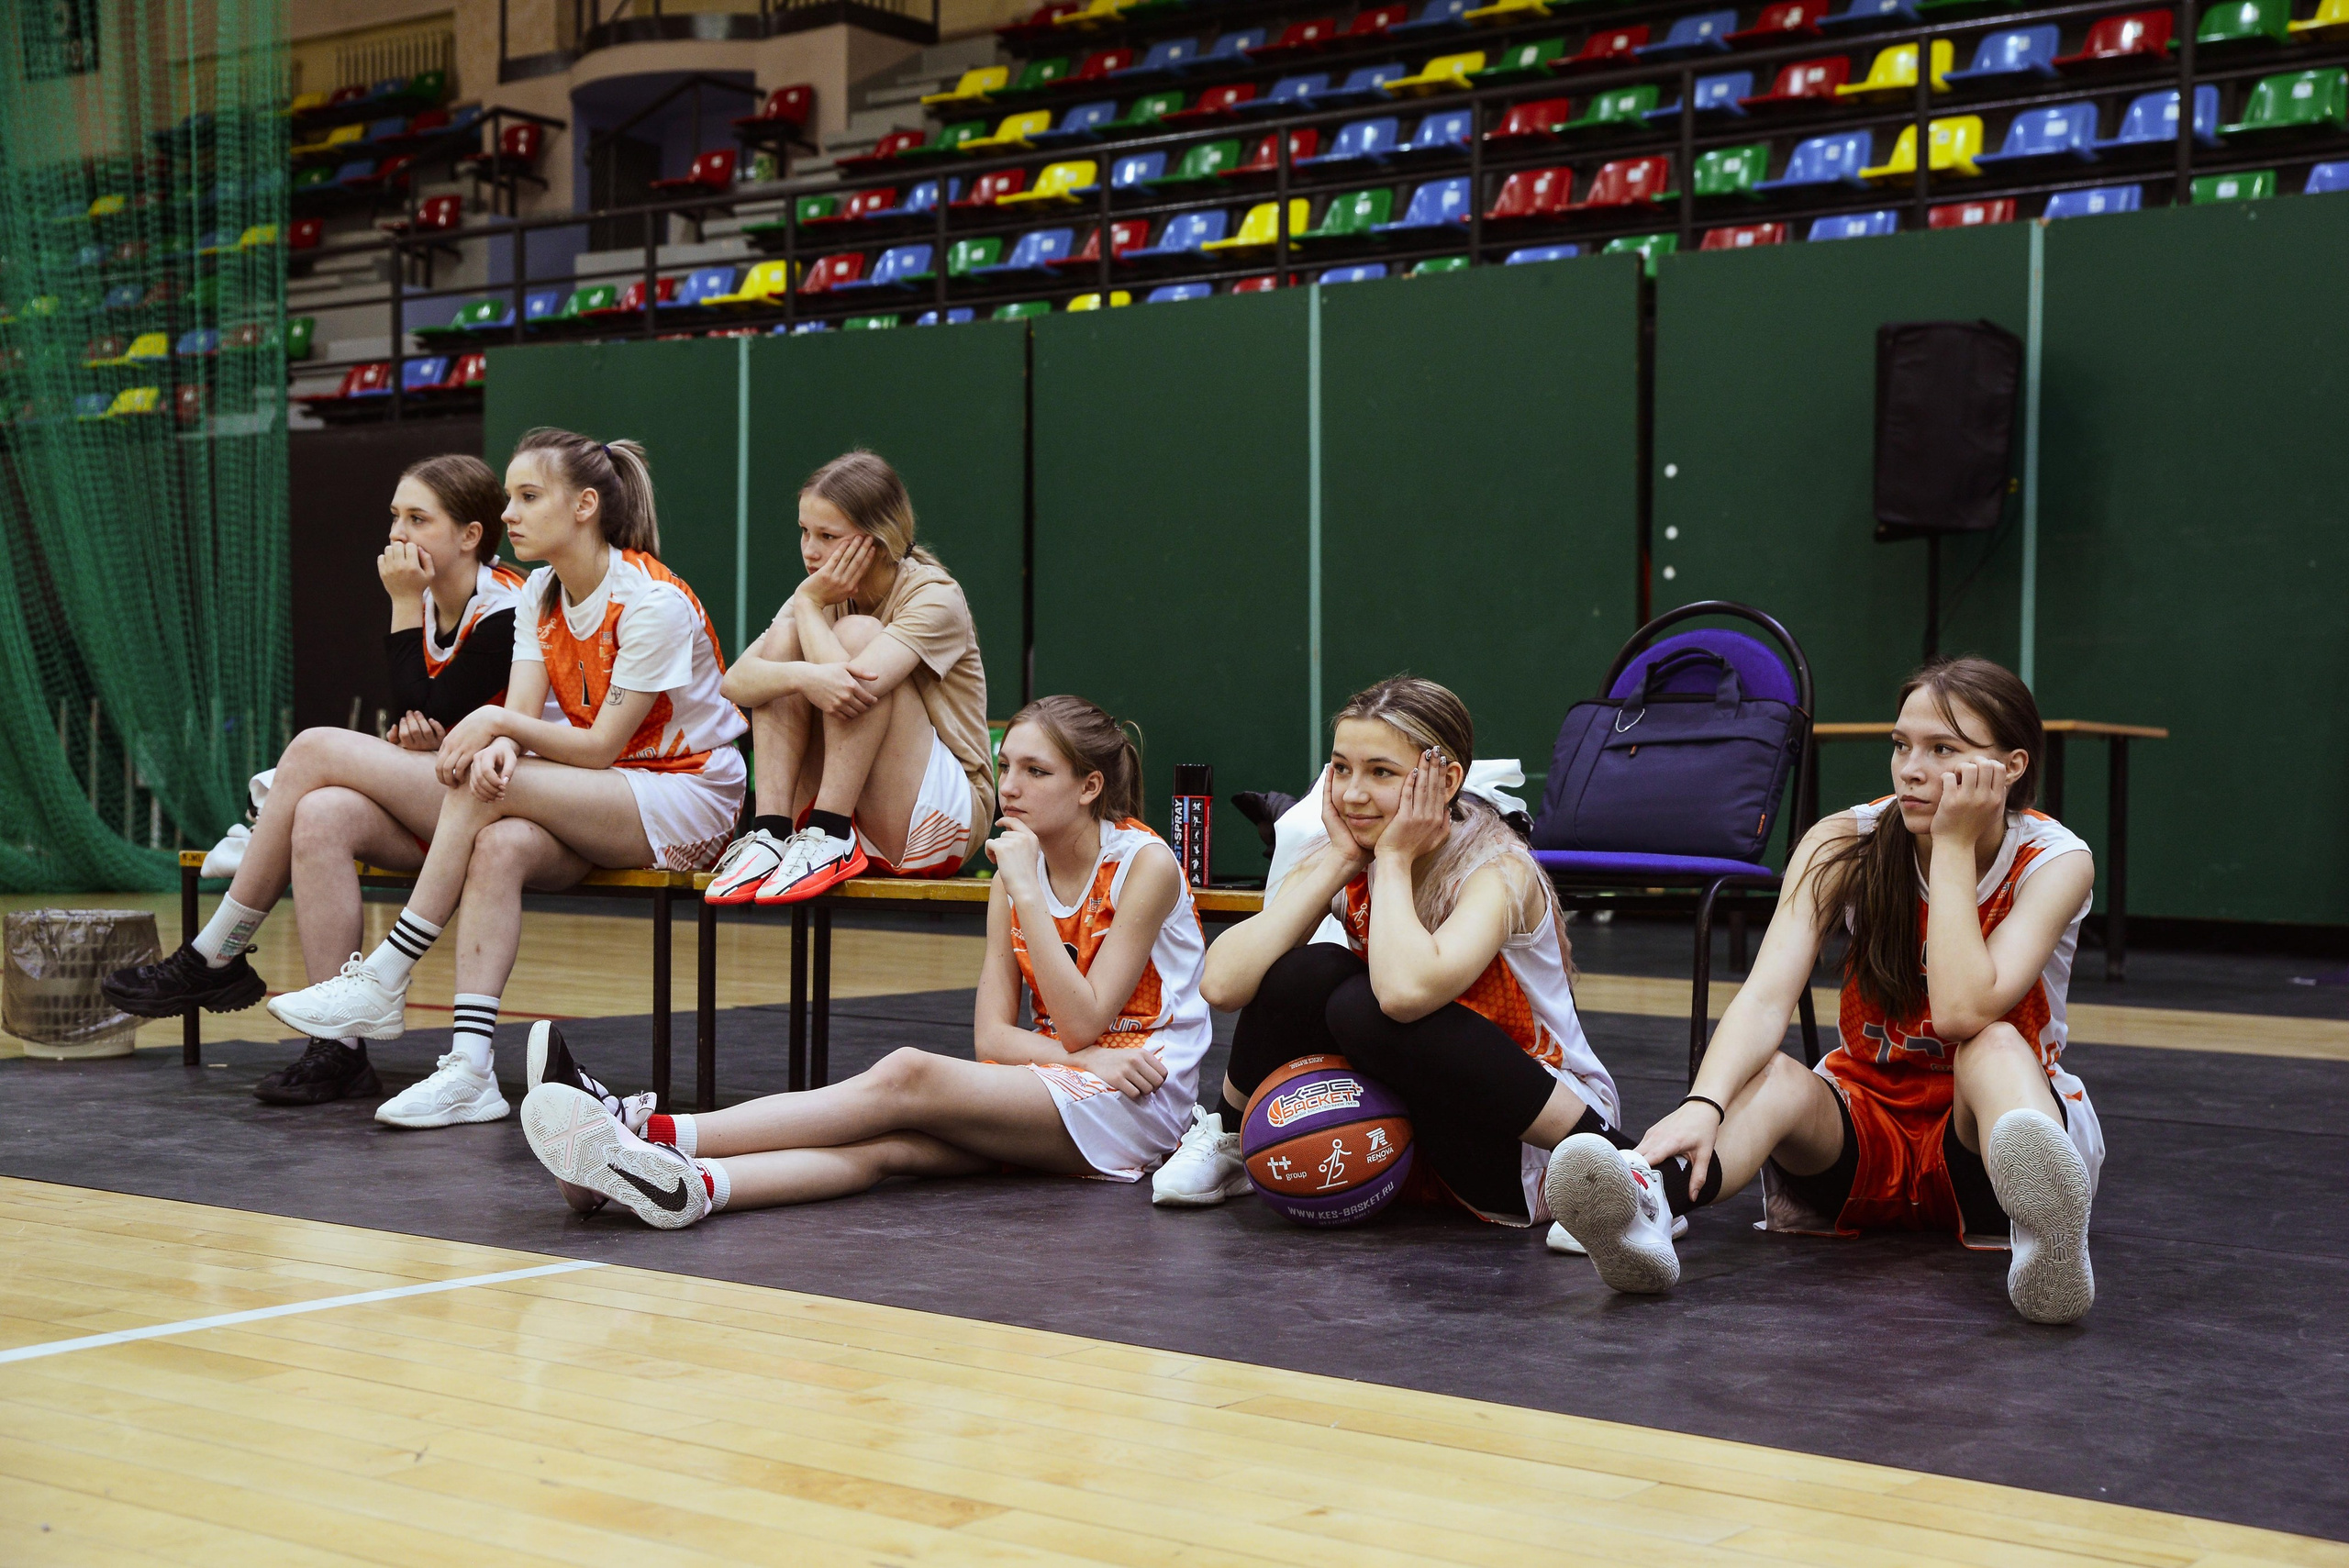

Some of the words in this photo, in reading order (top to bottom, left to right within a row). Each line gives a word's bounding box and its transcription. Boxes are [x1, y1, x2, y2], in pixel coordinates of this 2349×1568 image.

[1282, 1091, 1354, 1118] БАСКЕТ
[1366, 1147, 1395, 1164] RENOVA
[1286, 1170, 1308, 1181] group
[1287, 1181, 1396, 1219] WWW.KES-BASKET.RU
